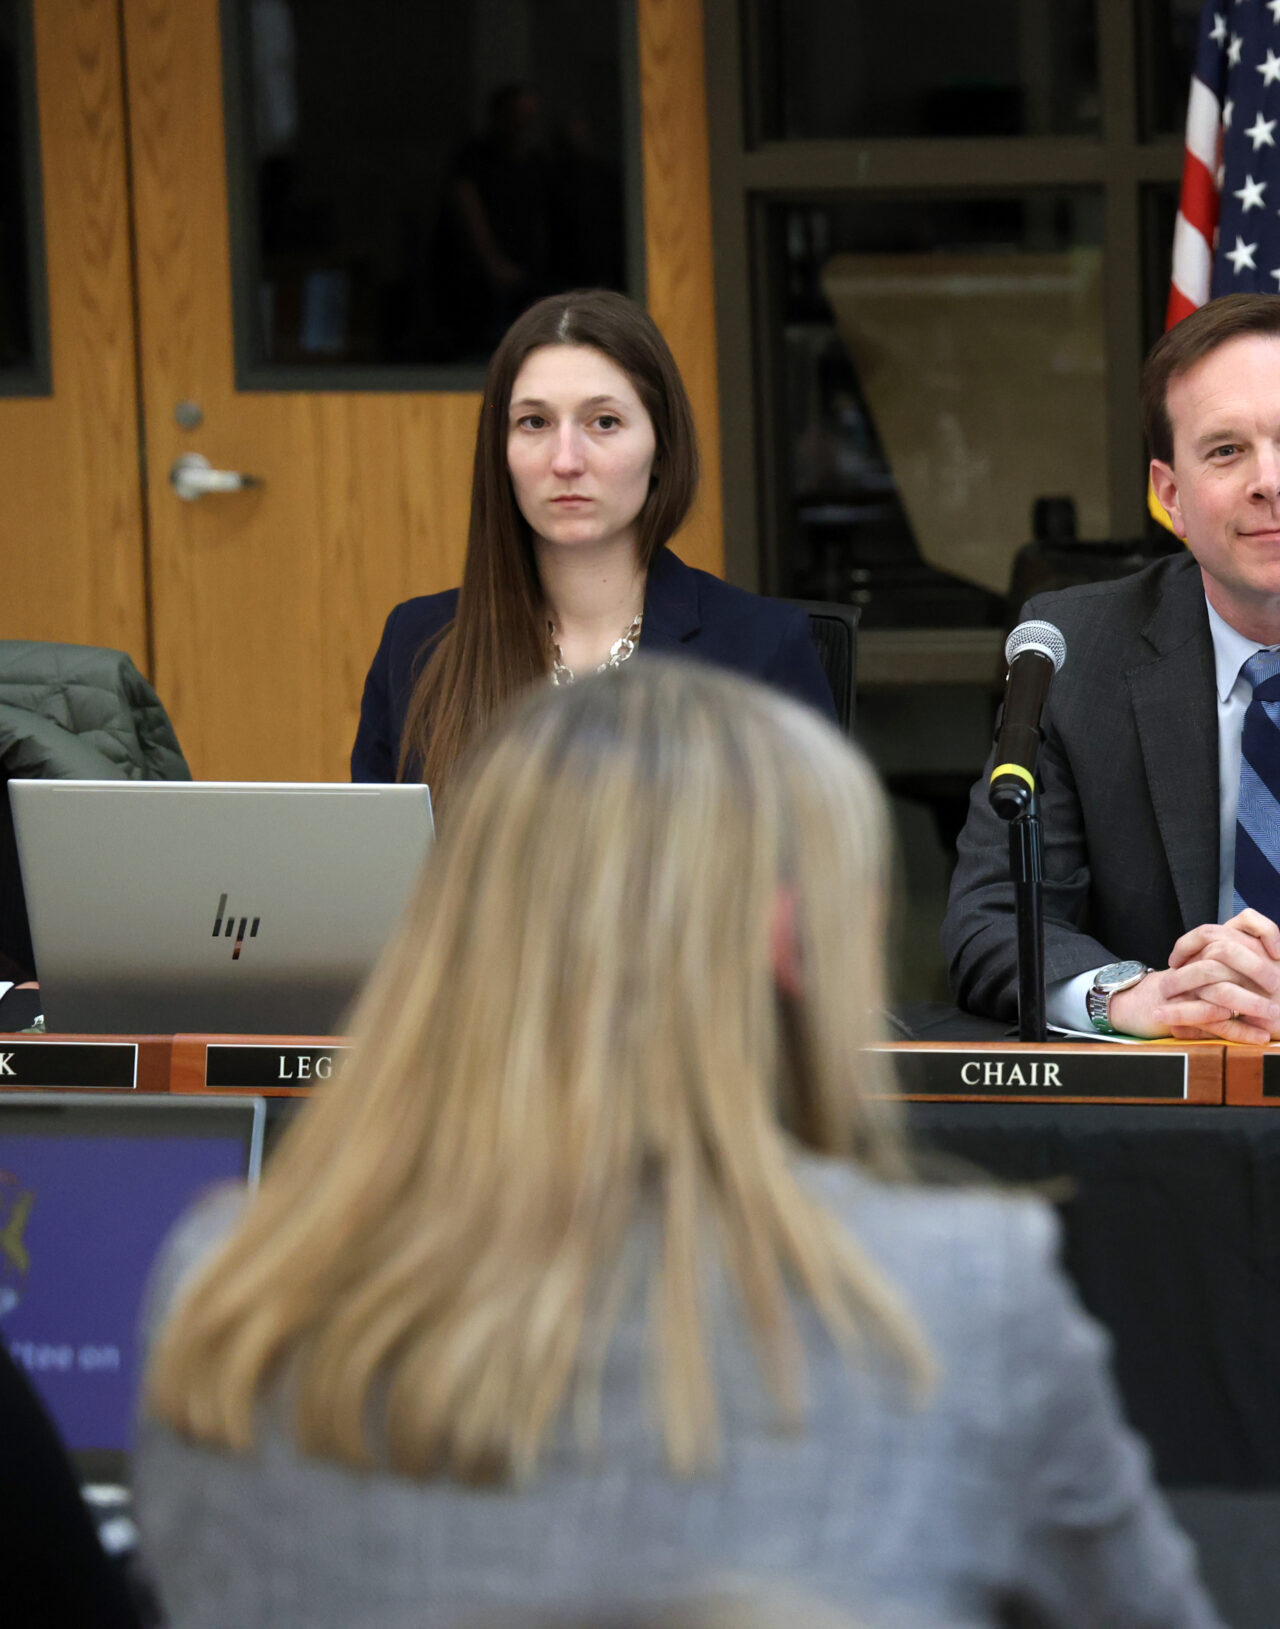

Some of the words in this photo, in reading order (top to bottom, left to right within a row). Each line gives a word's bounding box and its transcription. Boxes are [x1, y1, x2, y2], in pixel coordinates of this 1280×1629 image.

[212, 893, 260, 960] hp
[277, 1056, 333, 1079] LEG
[960, 1061, 1063, 1087] CHAIR
